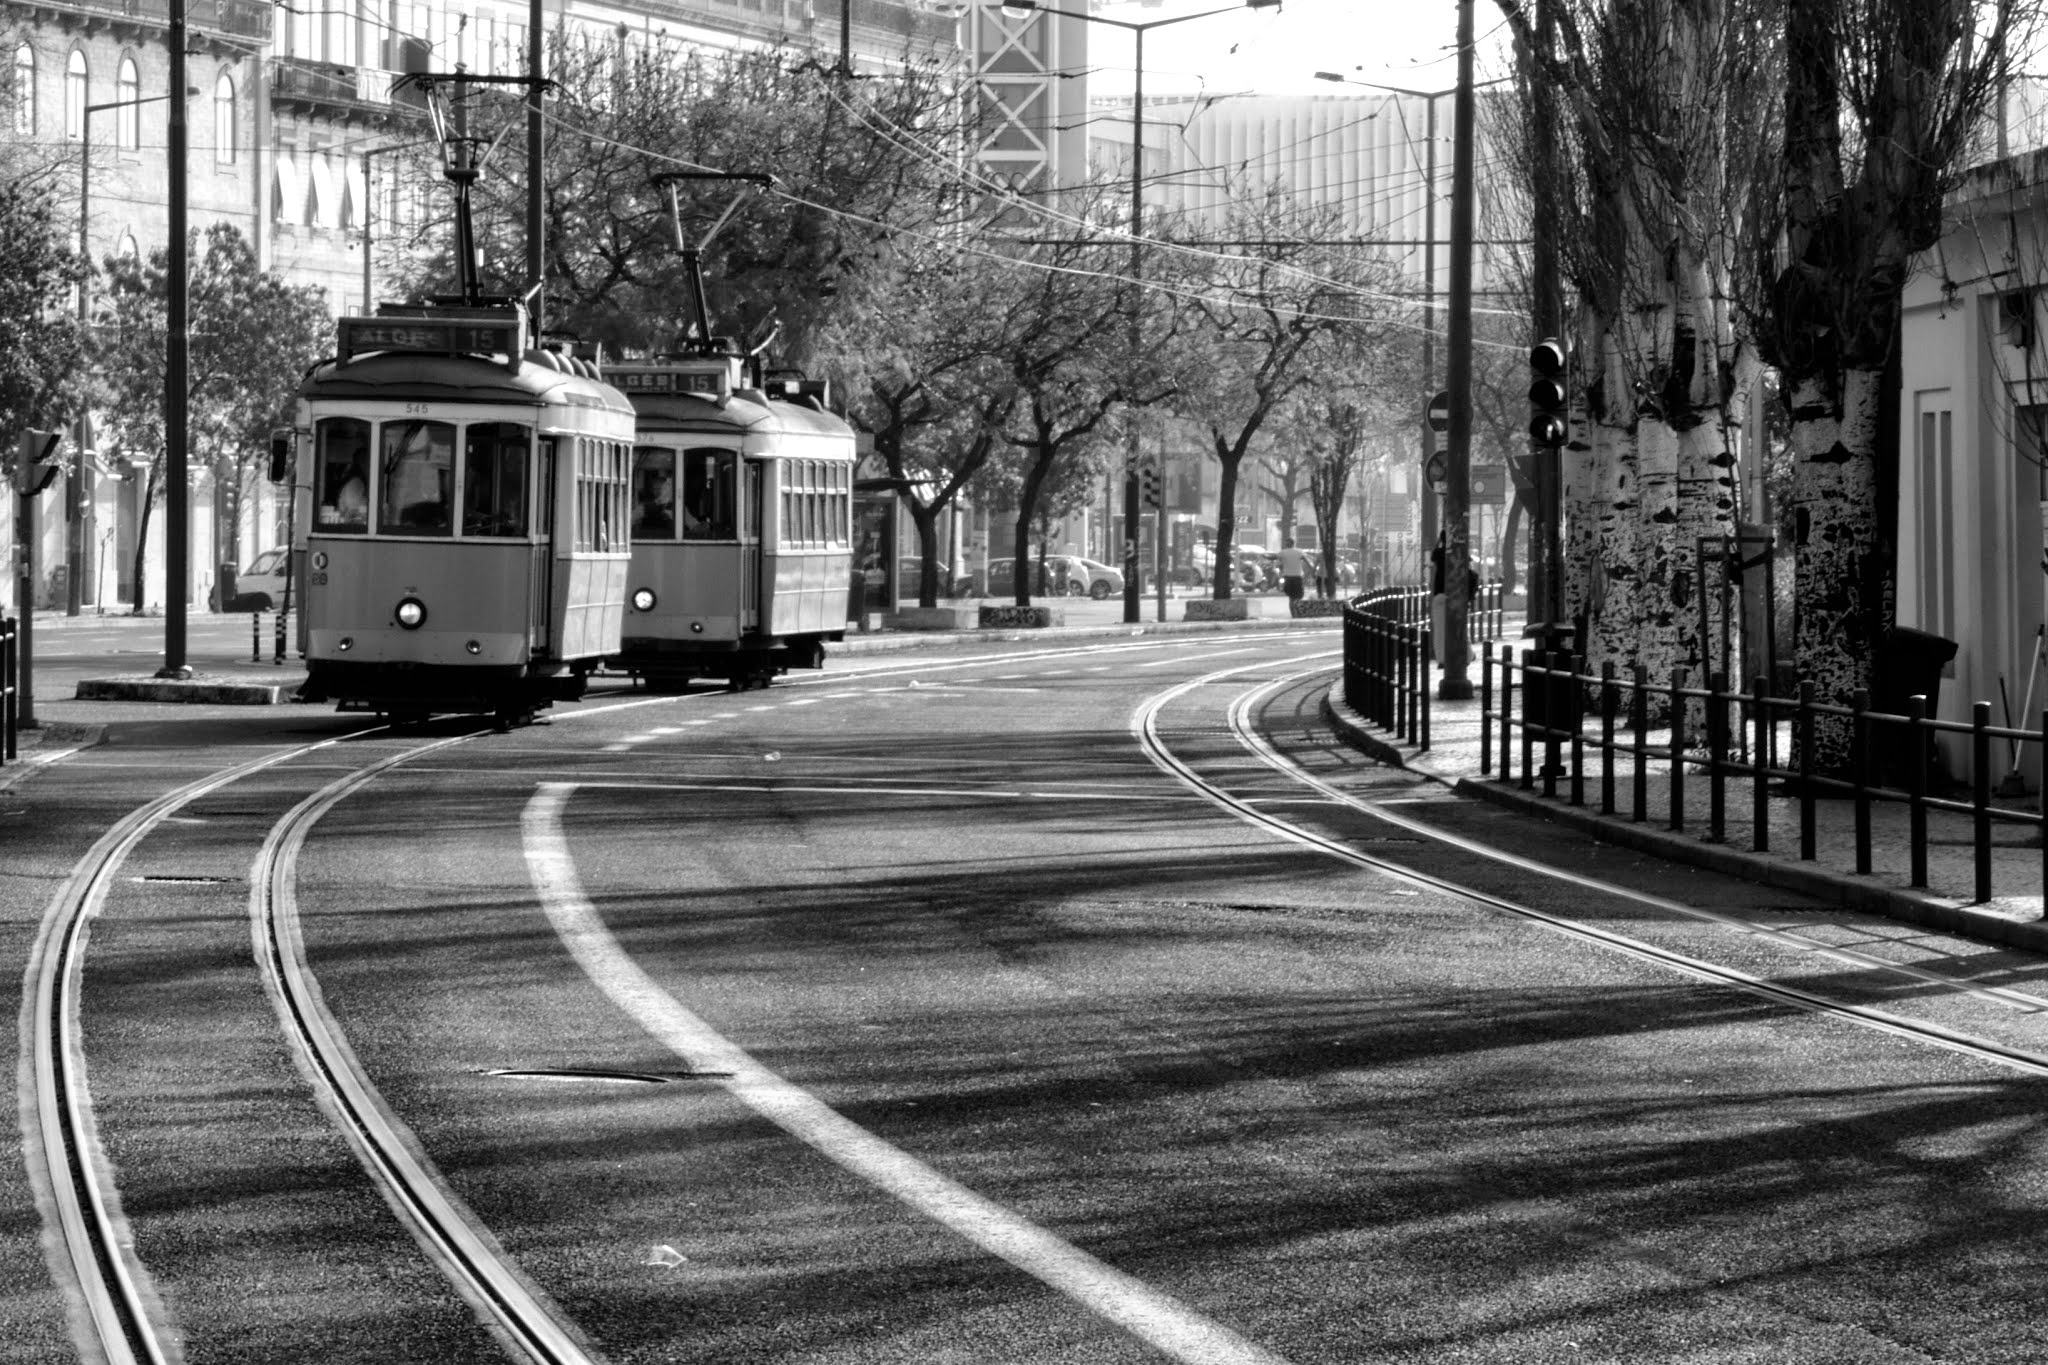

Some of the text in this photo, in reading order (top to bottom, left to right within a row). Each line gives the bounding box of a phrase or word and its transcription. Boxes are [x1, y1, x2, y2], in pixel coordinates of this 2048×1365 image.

[469, 329, 495, 349] 15
[688, 375, 709, 392] 15
[406, 404, 429, 414] 545
